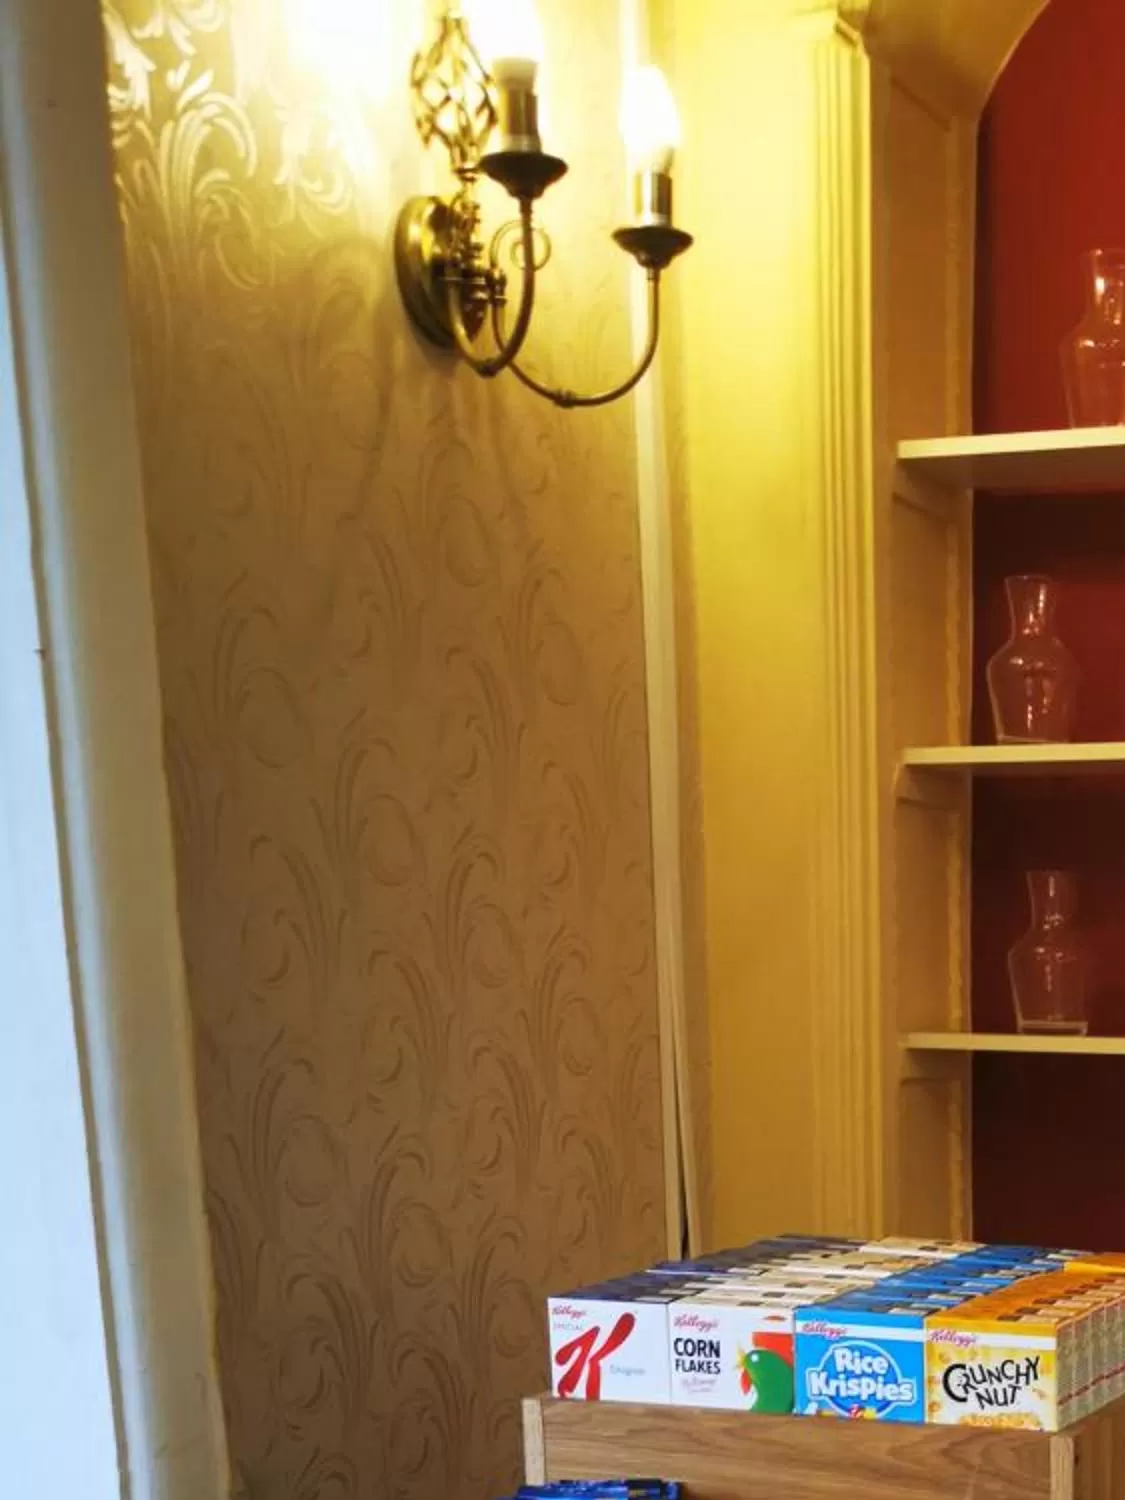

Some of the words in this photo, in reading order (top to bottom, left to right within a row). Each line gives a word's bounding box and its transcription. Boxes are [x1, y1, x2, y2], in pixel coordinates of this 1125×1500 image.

[674, 1314, 719, 1332] Kellogg's
[801, 1319, 848, 1339] Kellogg's
[673, 1337, 721, 1359] CORN
[929, 1329, 977, 1347] Kellogg's
[554, 1311, 637, 1401] K
[675, 1358, 721, 1375] FLAKES
[834, 1347, 889, 1375] Rice
[809, 1370, 914, 1401] Krispies
[942, 1355, 1041, 1403] CRUNCHY
[975, 1383, 1022, 1411] NUT
